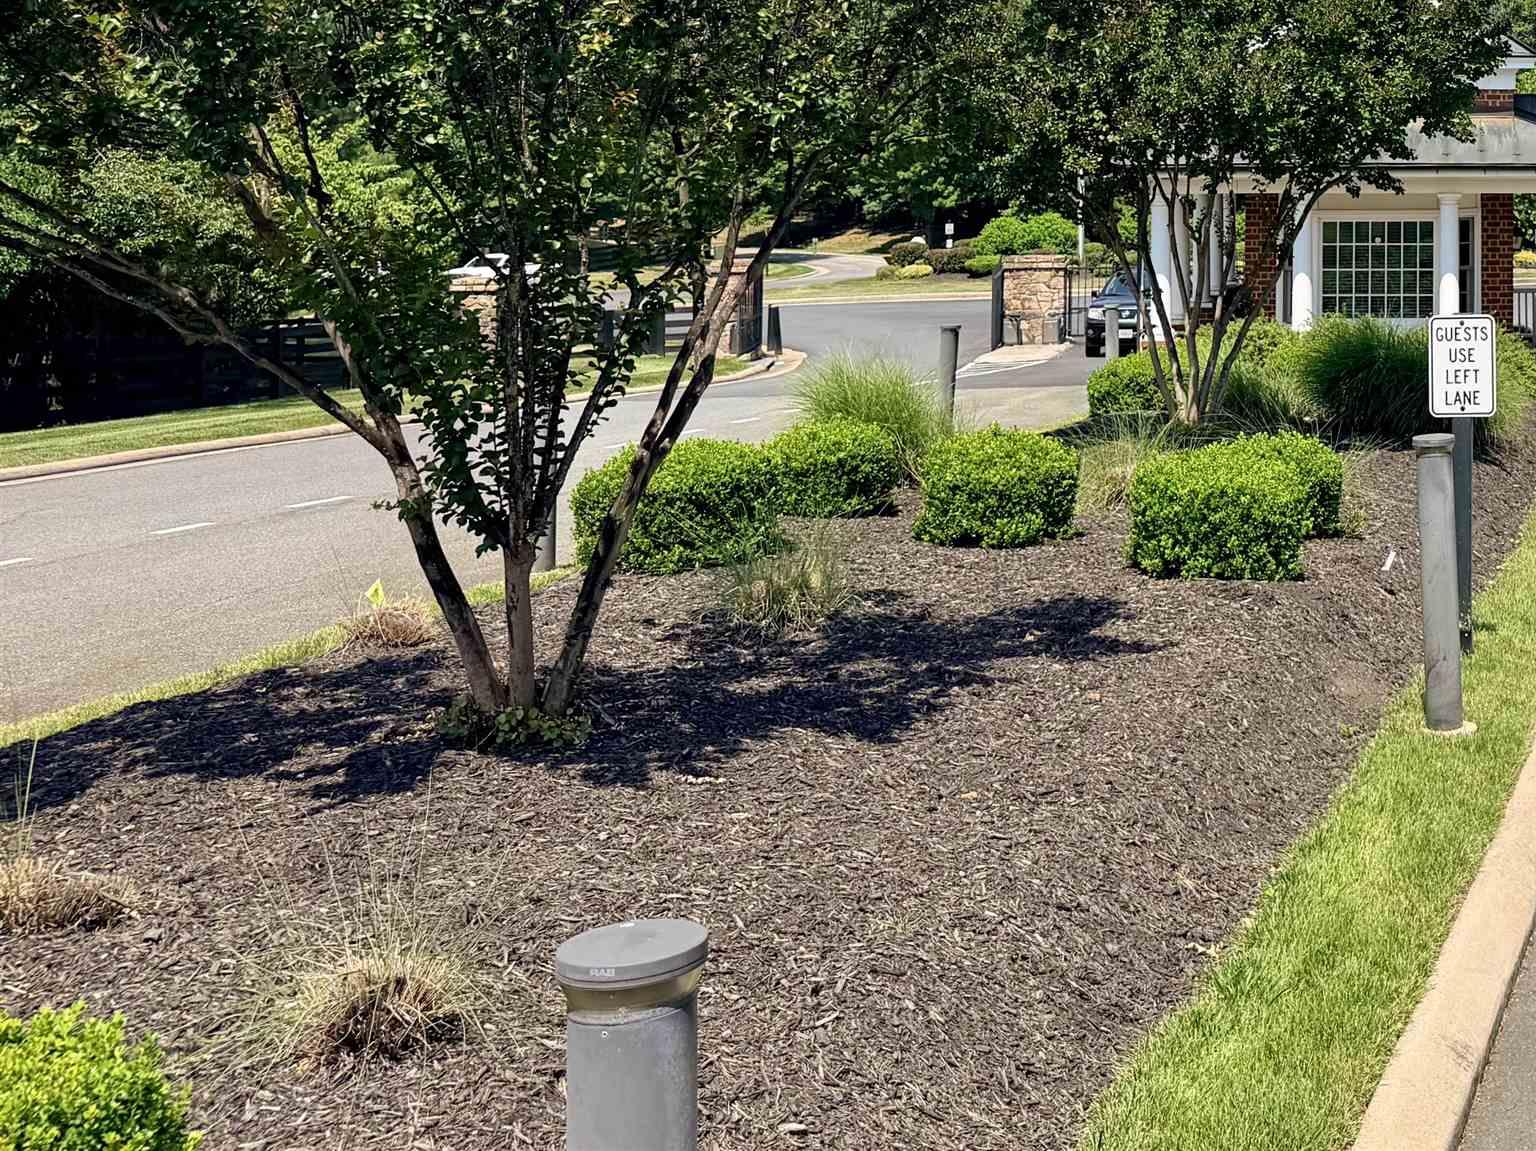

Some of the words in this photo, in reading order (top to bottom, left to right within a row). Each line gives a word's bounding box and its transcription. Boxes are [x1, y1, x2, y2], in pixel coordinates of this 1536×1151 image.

[1435, 326, 1489, 342] GUESTS
[1449, 347, 1475, 363] USE
[1445, 369, 1480, 385] LEFT
[1445, 390, 1481, 406] LANE
